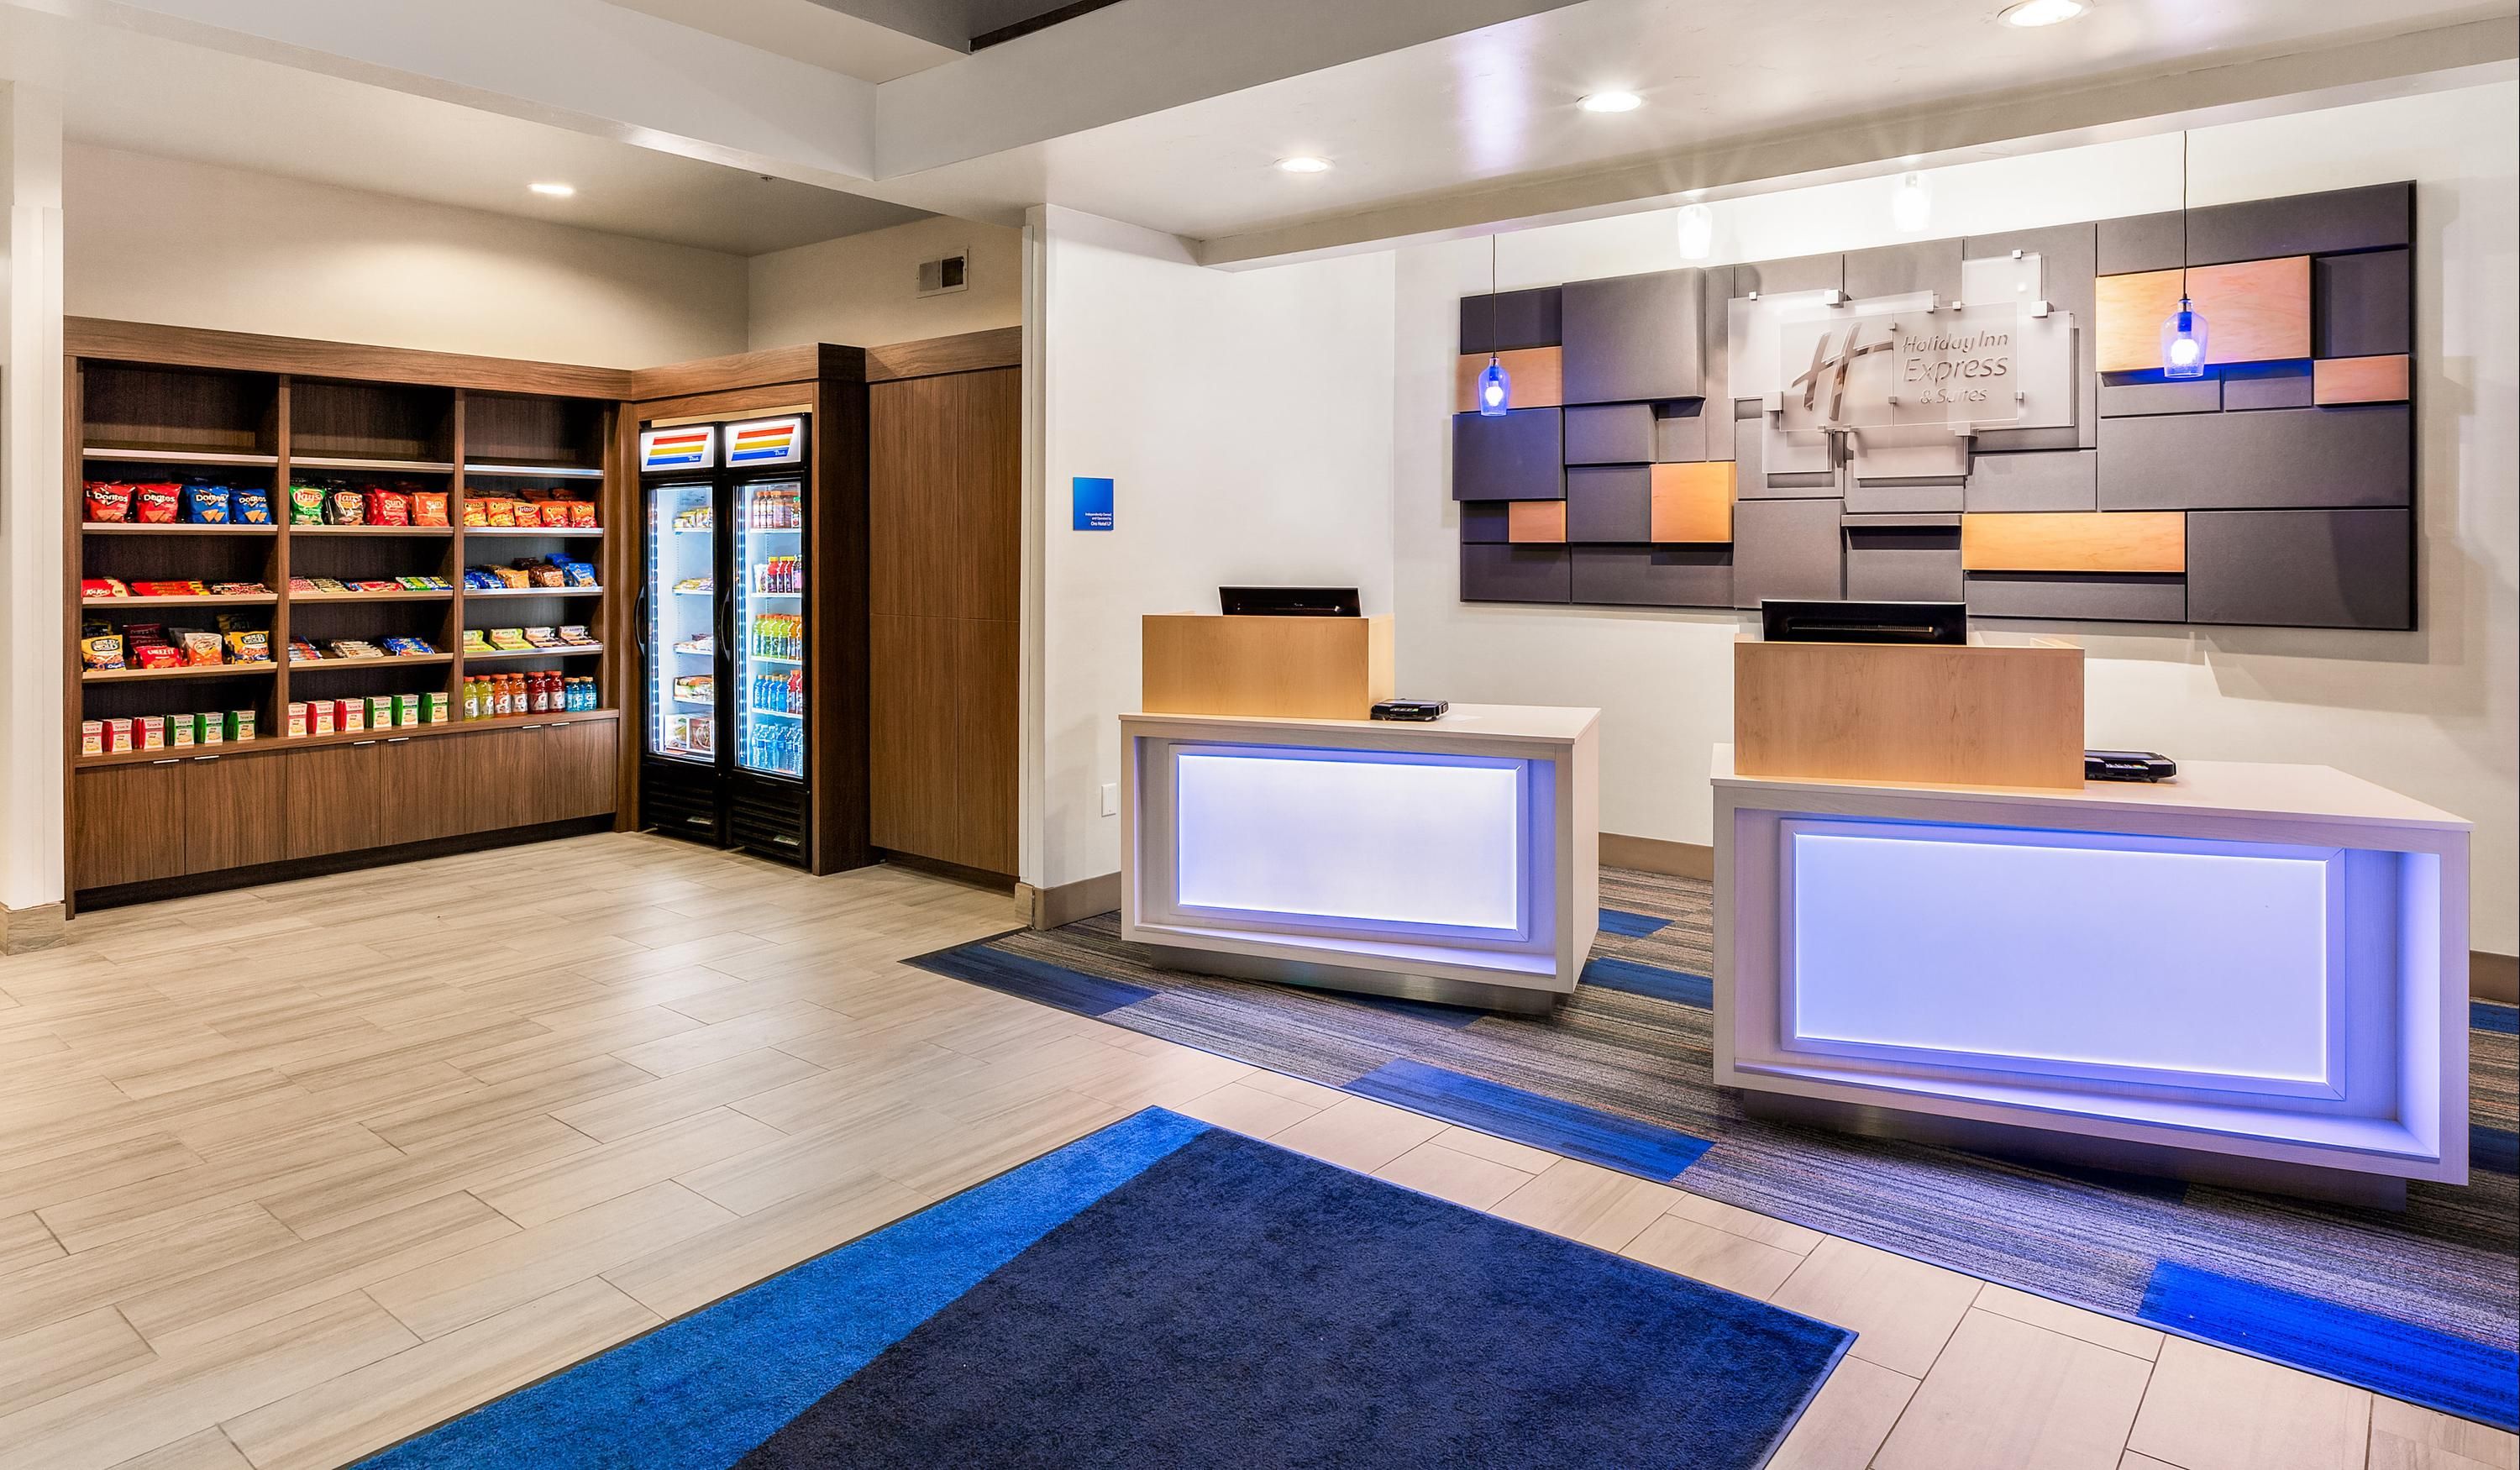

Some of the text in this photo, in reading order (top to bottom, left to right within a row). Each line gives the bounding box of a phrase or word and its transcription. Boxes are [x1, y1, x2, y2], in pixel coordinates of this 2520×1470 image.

[1903, 330, 2008, 353] Holiday Inn
[1903, 357, 2008, 386] Express
[1920, 388, 1987, 404] & Suites
[94, 492, 129, 502] Doritos
[144, 494, 176, 502] Doritos
[196, 494, 226, 502] Doritos
[239, 496, 266, 504] Doritos
